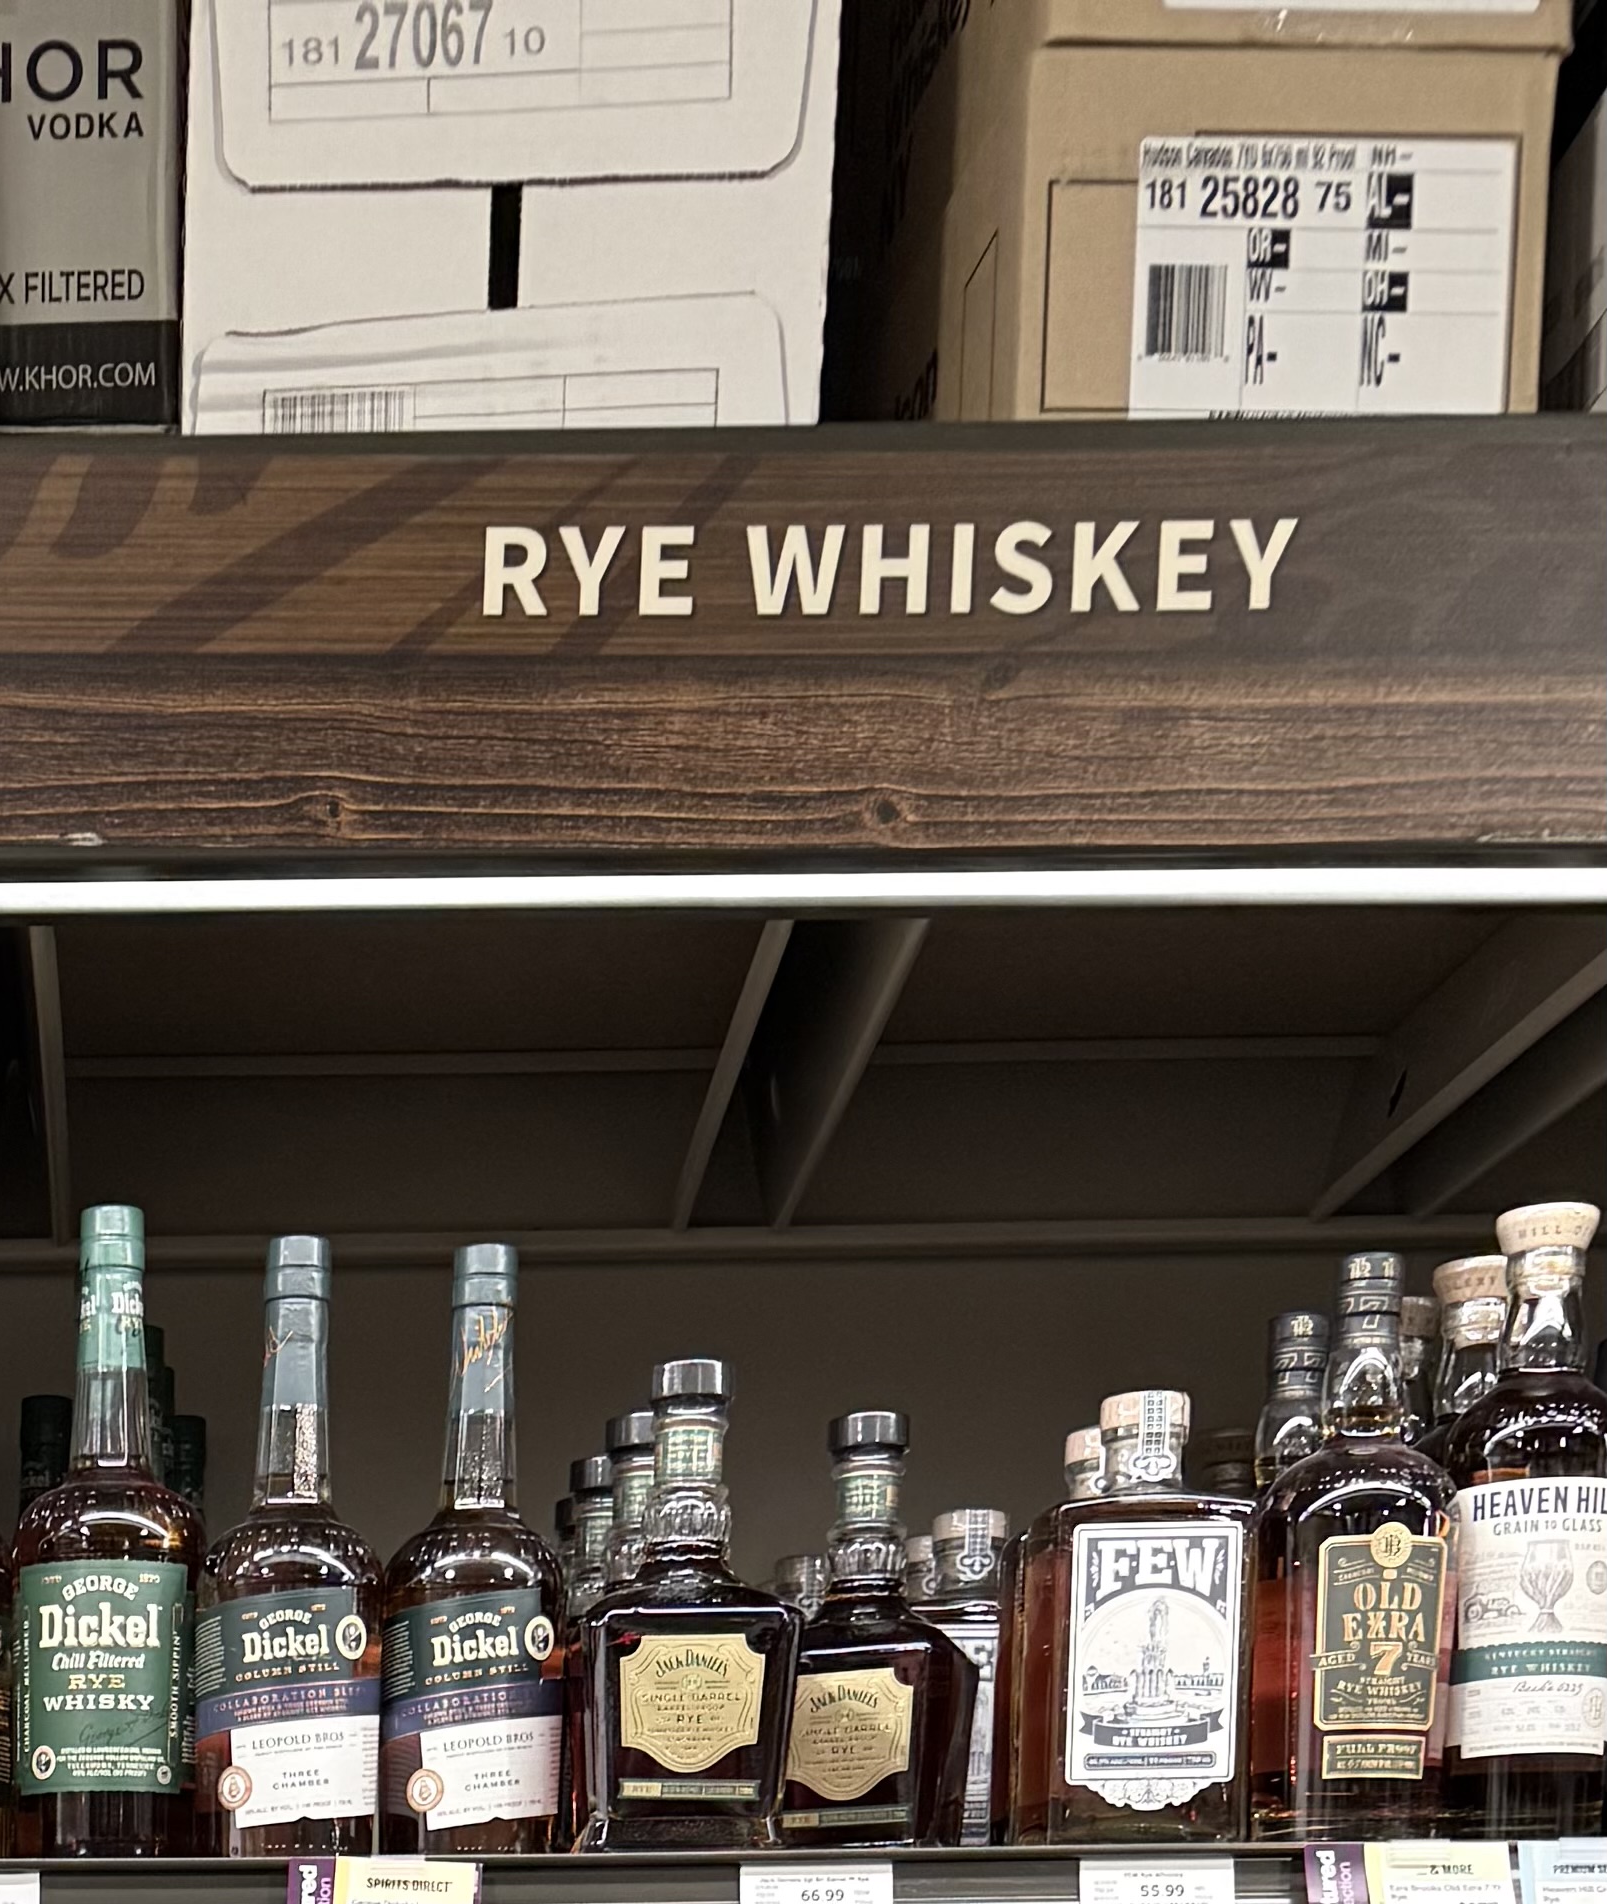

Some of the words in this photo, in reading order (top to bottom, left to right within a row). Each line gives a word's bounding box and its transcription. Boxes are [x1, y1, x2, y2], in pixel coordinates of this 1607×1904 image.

[280, 36, 341, 67] 181
[354, 0, 491, 71] 27067
[503, 26, 546, 57] 10
[26, 112, 144, 140] VODKA
[1146, 179, 1188, 209] 181
[1200, 175, 1301, 218] 25828
[1315, 180, 1352, 213] 75
[24, 269, 145, 305] FILTERED
[481, 524, 695, 616] RYE
[746, 518, 1299, 615] WHISKEY
[1473, 1487, 1570, 1522] HEAVEN
[1354, 1580, 1422, 1610] OLD
[40, 1603, 160, 1648] Dickel
[366, 1876, 408, 1894] SPIRITS
[410, 1879, 451, 1894] DIRECT
[1141, 1883, 1184, 1898] 55.99
